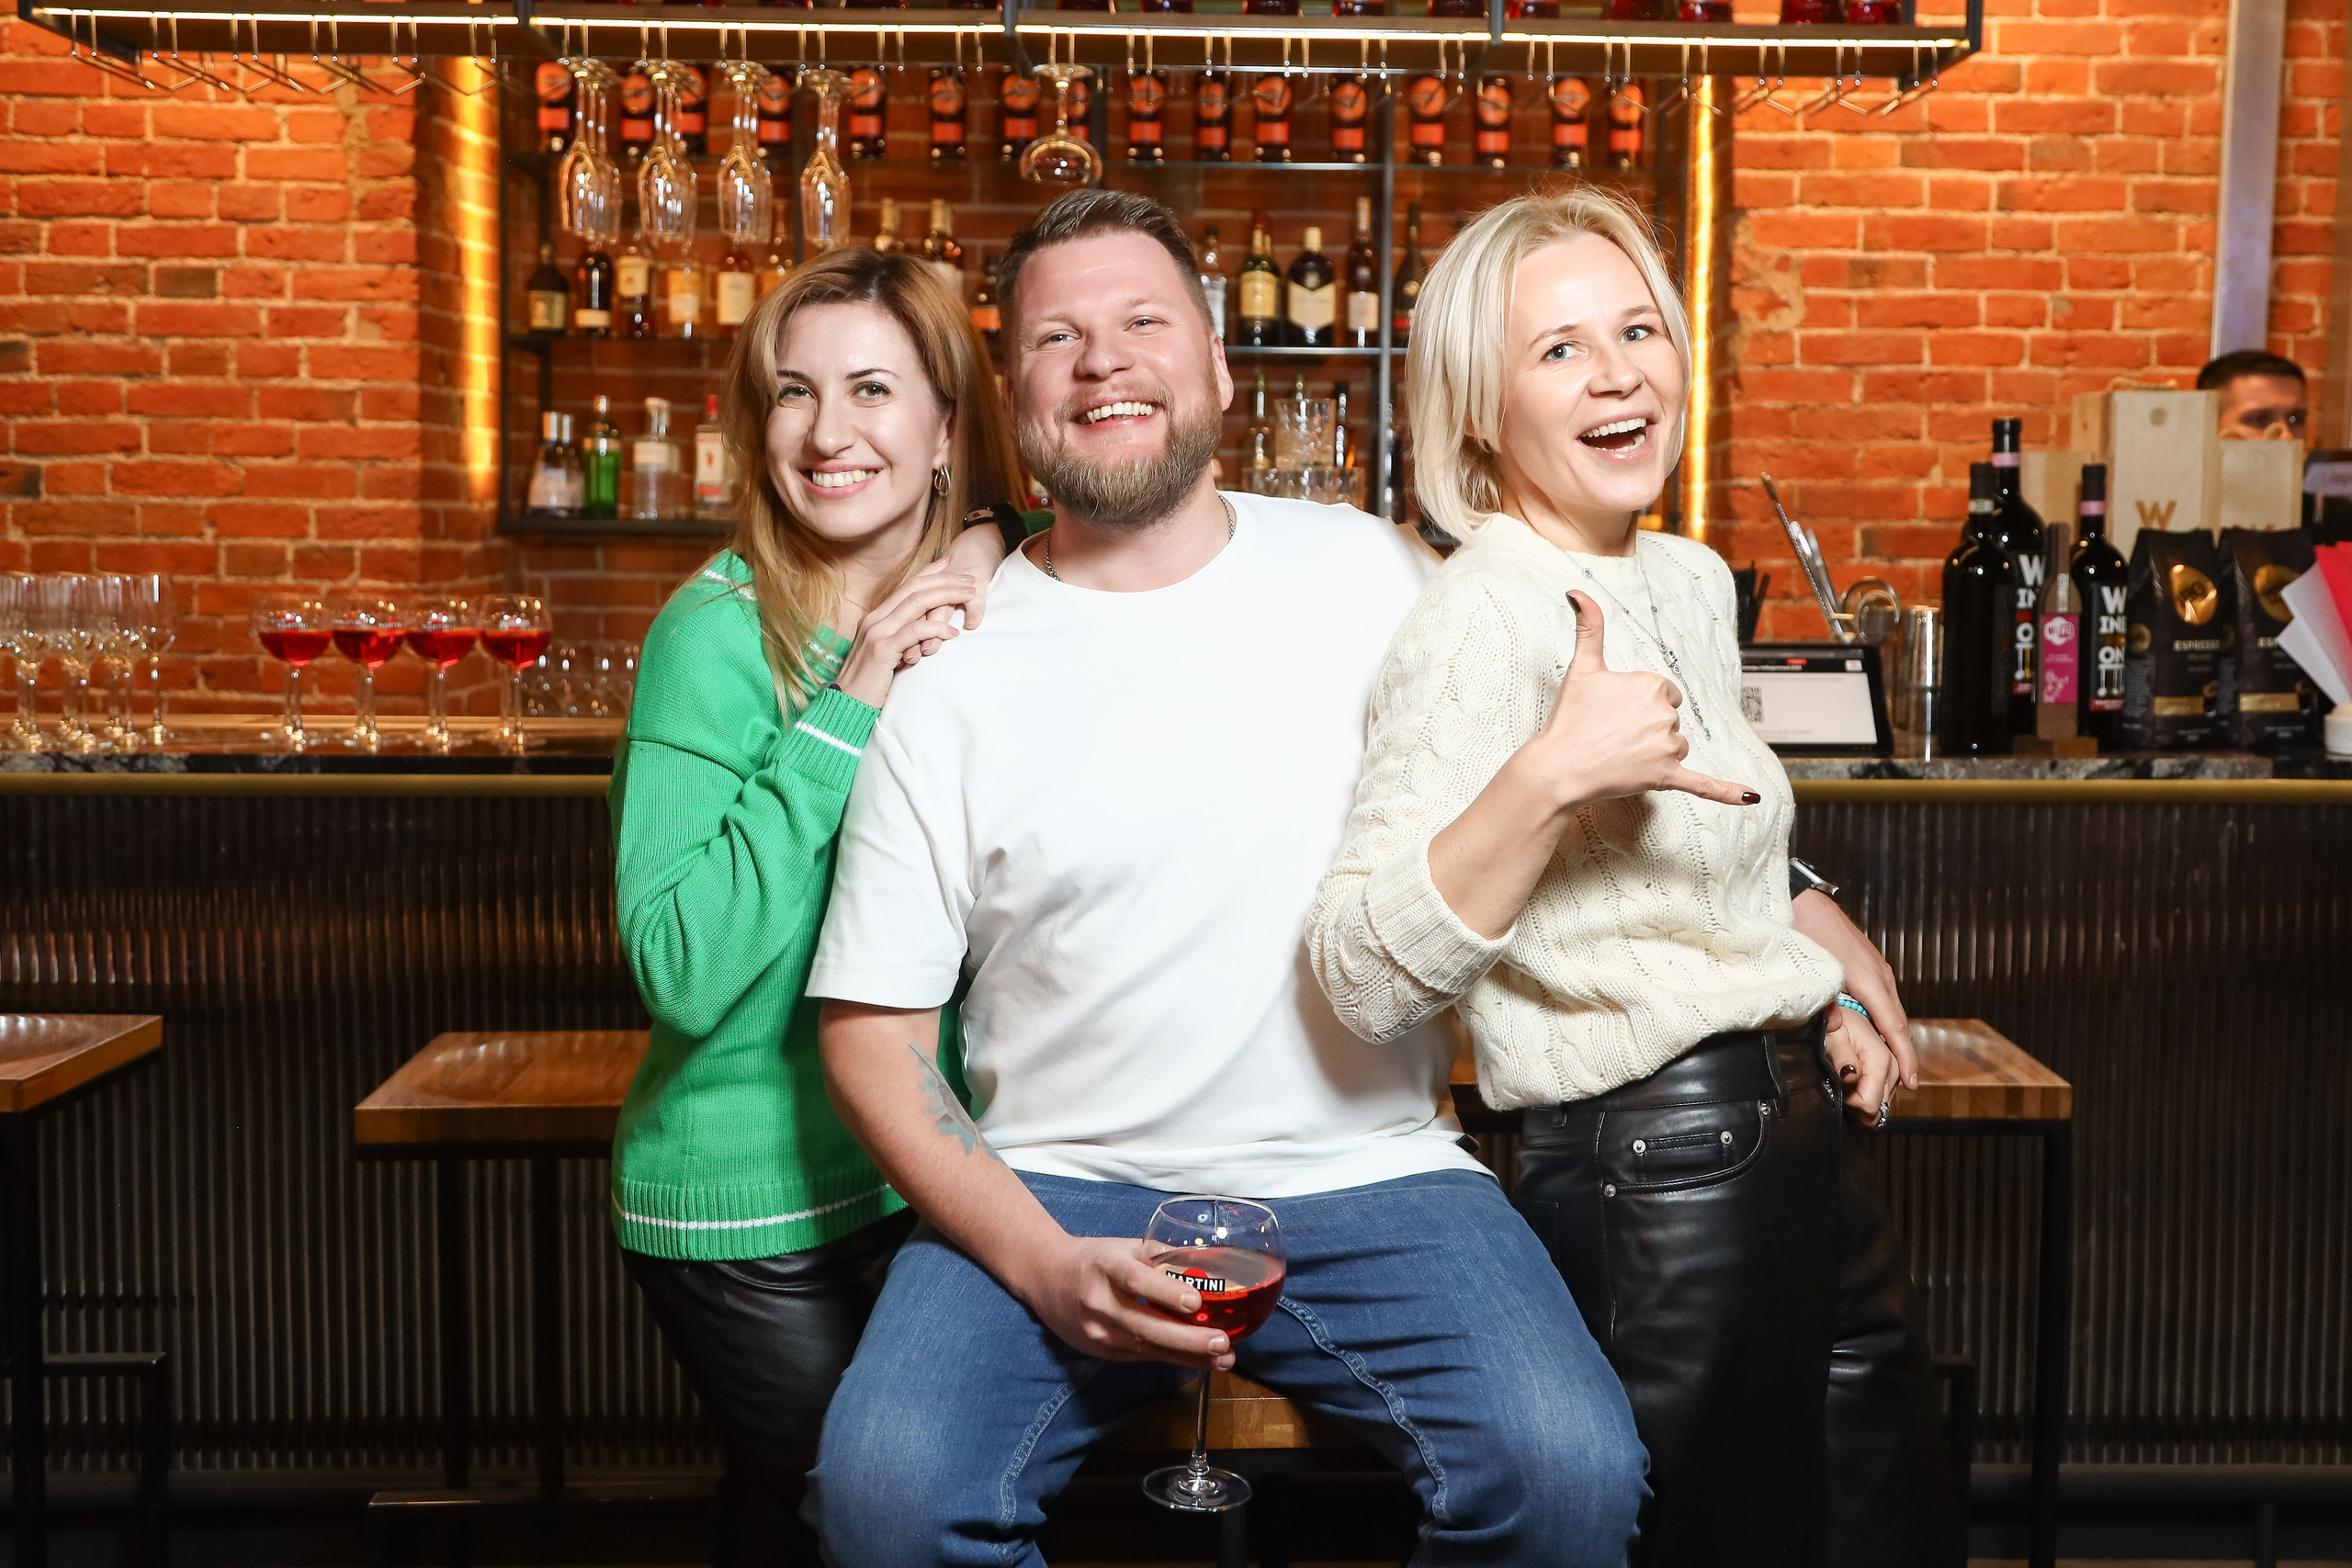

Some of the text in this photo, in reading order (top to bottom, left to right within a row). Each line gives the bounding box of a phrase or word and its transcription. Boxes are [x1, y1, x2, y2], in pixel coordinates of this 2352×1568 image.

[2135, 501, 2177, 531] W
[2018, 554, 2046, 587] W
[2100, 585, 2128, 615] W
